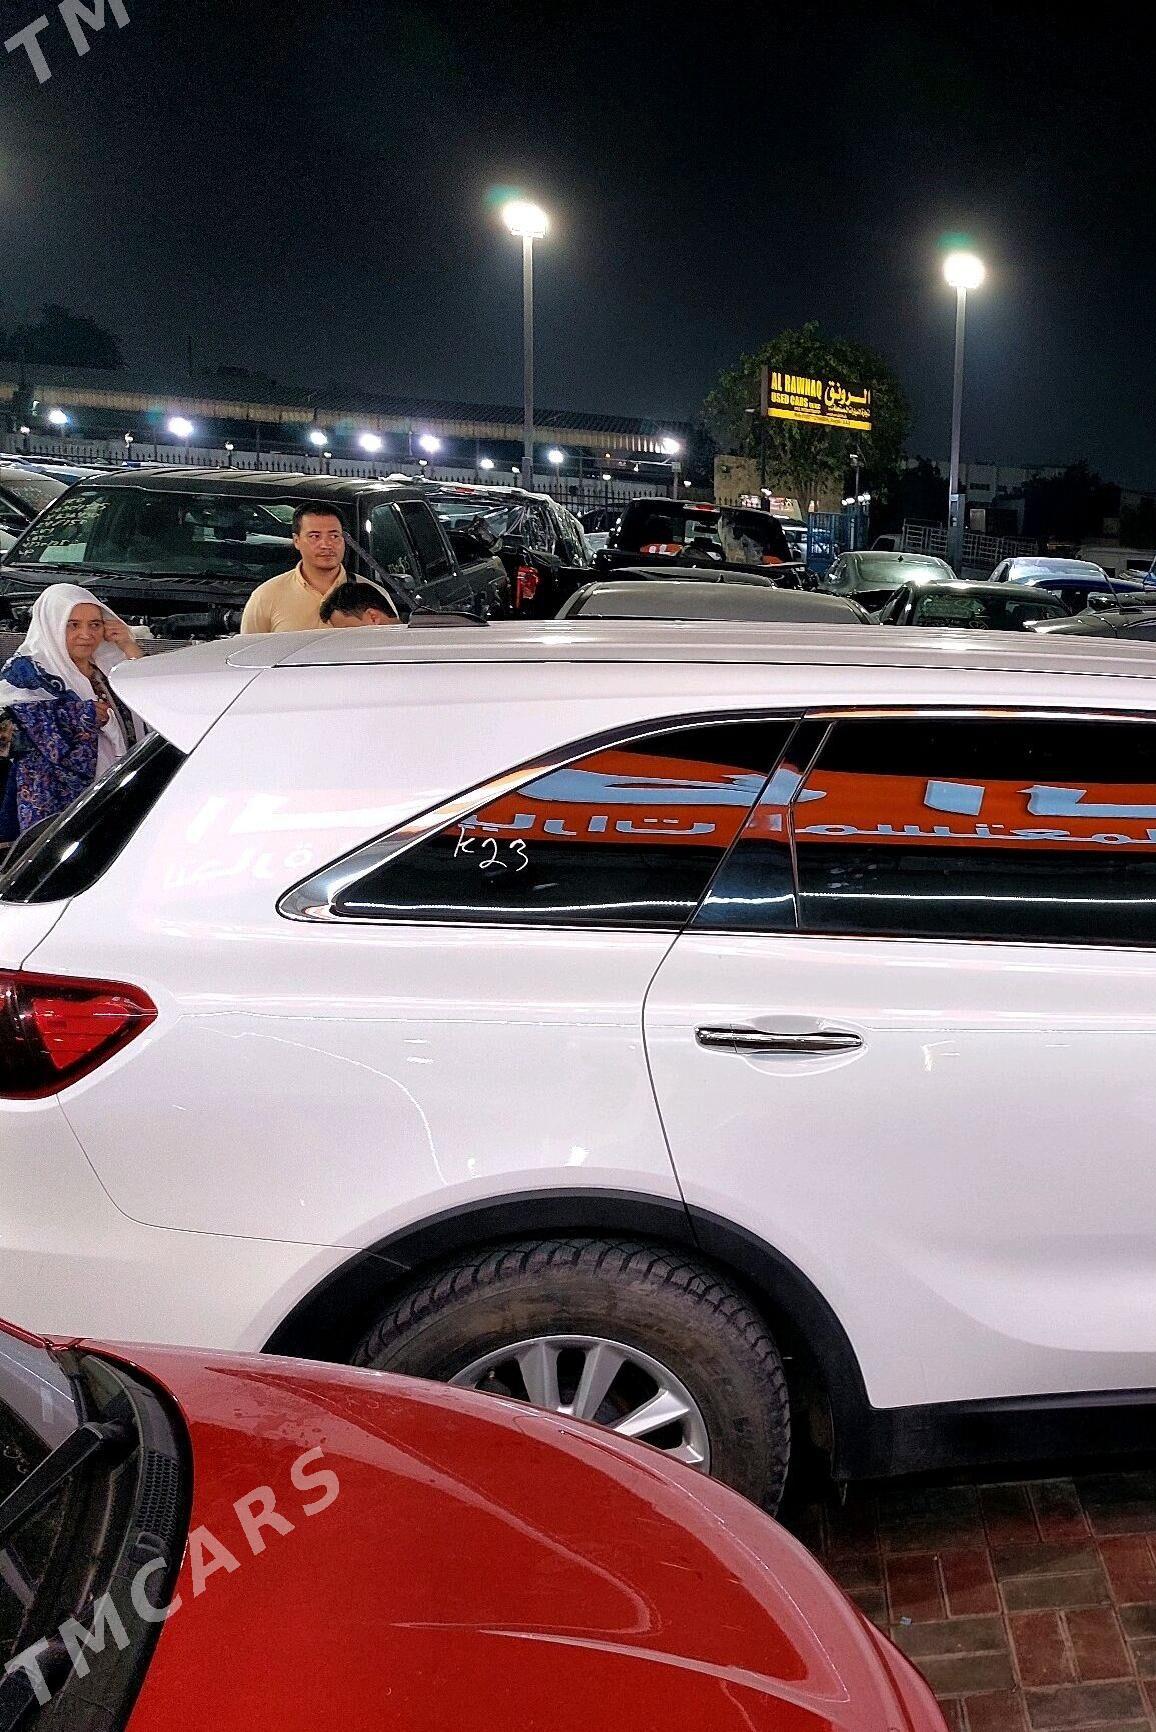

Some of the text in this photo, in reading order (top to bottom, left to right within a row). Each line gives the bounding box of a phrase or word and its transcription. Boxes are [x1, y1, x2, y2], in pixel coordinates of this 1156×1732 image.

[771, 371, 823, 400] AL RAWNAQ
[770, 391, 790, 405] USED
[790, 395, 809, 408] CARS
